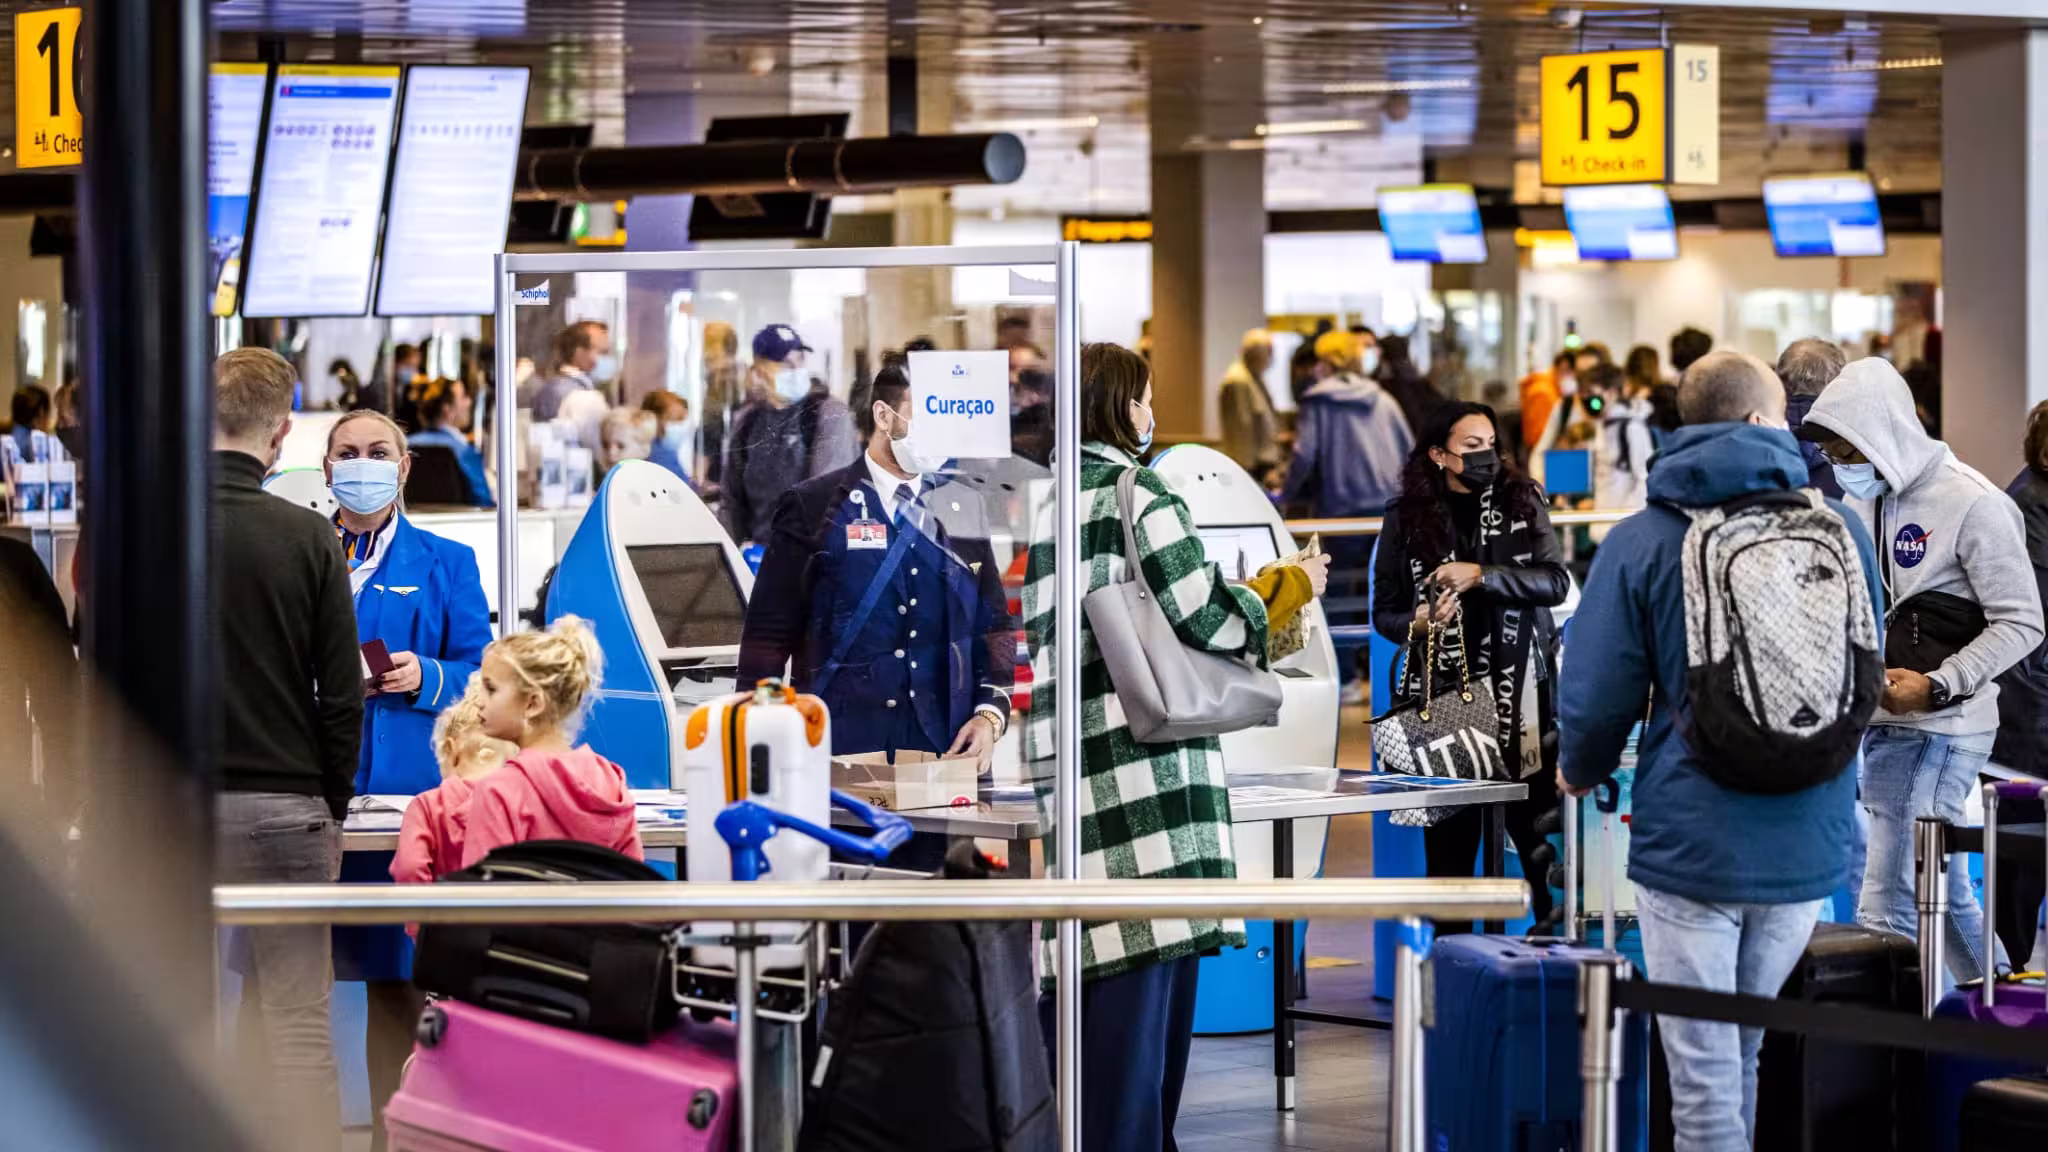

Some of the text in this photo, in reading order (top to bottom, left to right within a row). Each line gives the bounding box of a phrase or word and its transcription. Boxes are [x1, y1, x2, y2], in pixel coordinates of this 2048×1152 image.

[1685, 59, 1708, 82] 15
[1567, 61, 1640, 142] 15
[1583, 155, 1646, 174] Check-in
[925, 394, 995, 420] Curaçao
[1895, 540, 1924, 552] NASA
[1497, 663, 1517, 749] VOGUE
